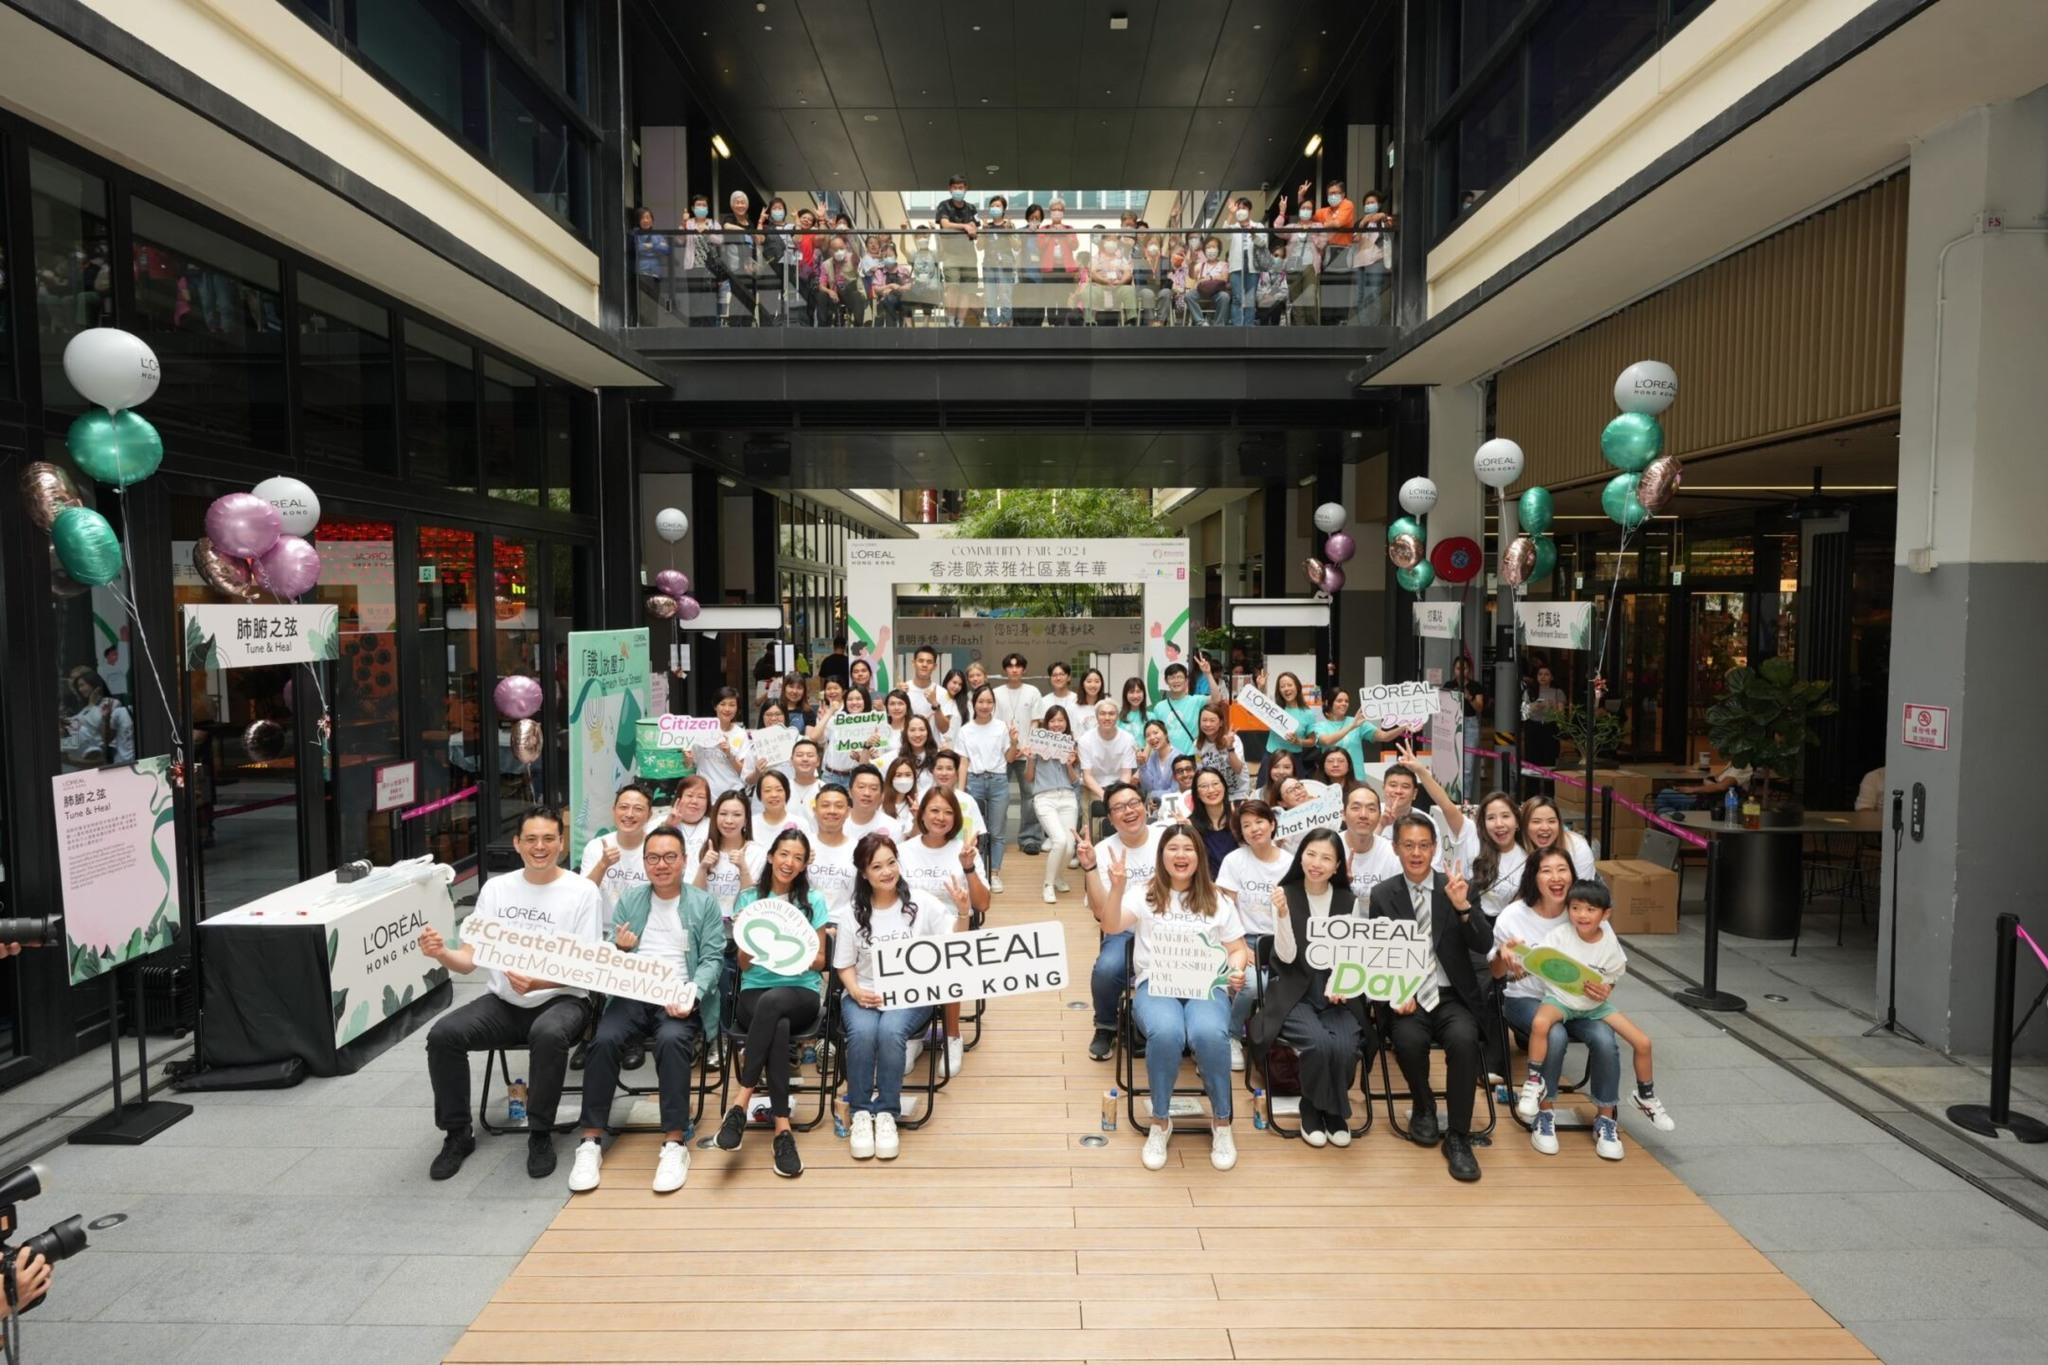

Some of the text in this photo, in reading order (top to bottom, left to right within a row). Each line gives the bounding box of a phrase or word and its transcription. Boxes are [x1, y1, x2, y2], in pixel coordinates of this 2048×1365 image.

[1027, 545, 1051, 556] FAIR
[245, 641, 292, 654] Tune & Heal
[951, 634, 983, 645] Flash!
[1361, 682, 1436, 701] L'ORÉAL
[836, 712, 885, 725] Beauty
[1364, 697, 1440, 719] CITIZEN
[659, 716, 719, 731] Citizen
[660, 732, 696, 748] Day
[65, 810, 84, 820] Tune
[94, 802, 111, 814] Heal
[497, 905, 557, 925] L'ORÉAL
[363, 909, 429, 956] L'ORÉAL
[1310, 919, 1427, 942] L'ORÉAL
[366, 939, 417, 975] HONG KO
[465, 918, 673, 982] #CreateTheBeauty
[877, 932, 1060, 978] L'ORÉAL
[1309, 944, 1427, 969] CITIZEN
[477, 941, 692, 1005] ThatMovesTheWorld
[1331, 962, 1423, 1005] Day
[883, 971, 1062, 1006] HONG KONG
